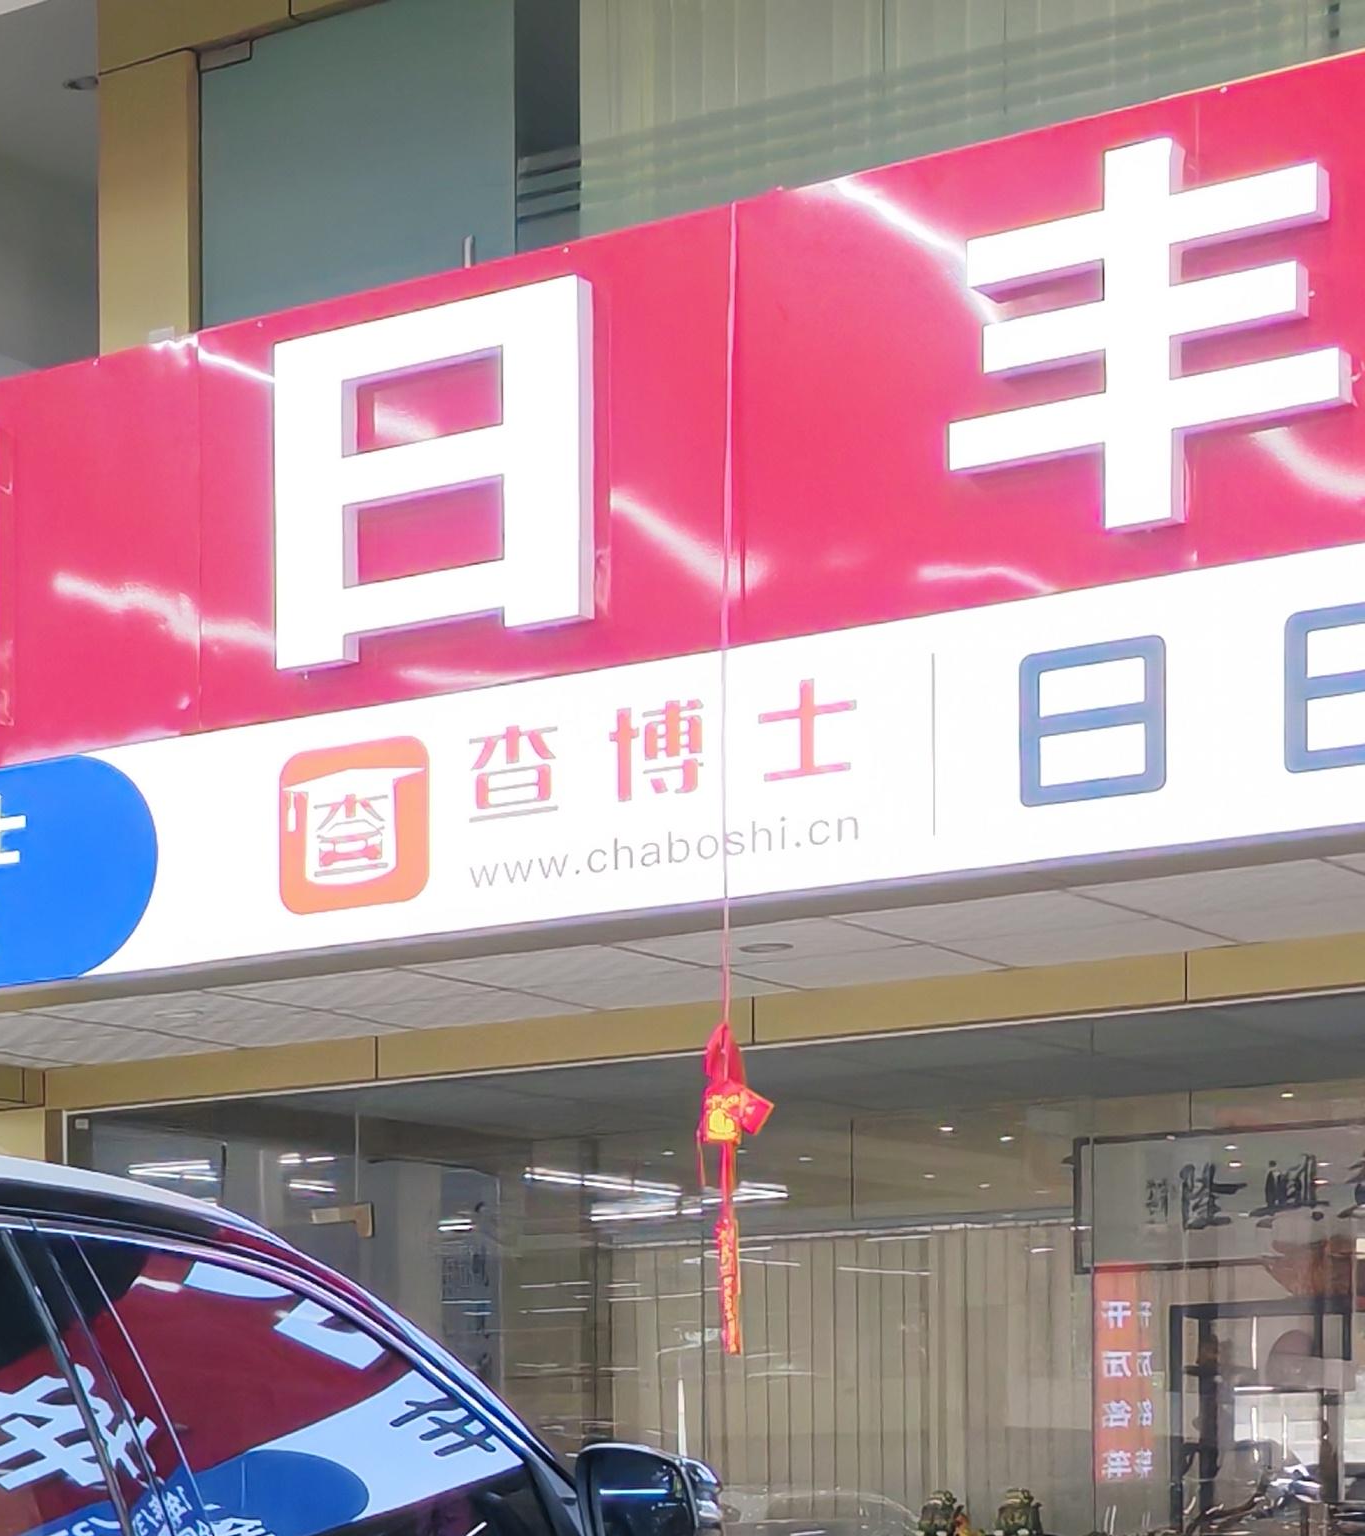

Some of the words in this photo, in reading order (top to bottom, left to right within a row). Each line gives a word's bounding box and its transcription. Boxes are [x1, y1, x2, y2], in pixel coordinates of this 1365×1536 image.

[468, 677, 858, 823] 查博士
[468, 814, 860, 889] www.chaboshi.cn
